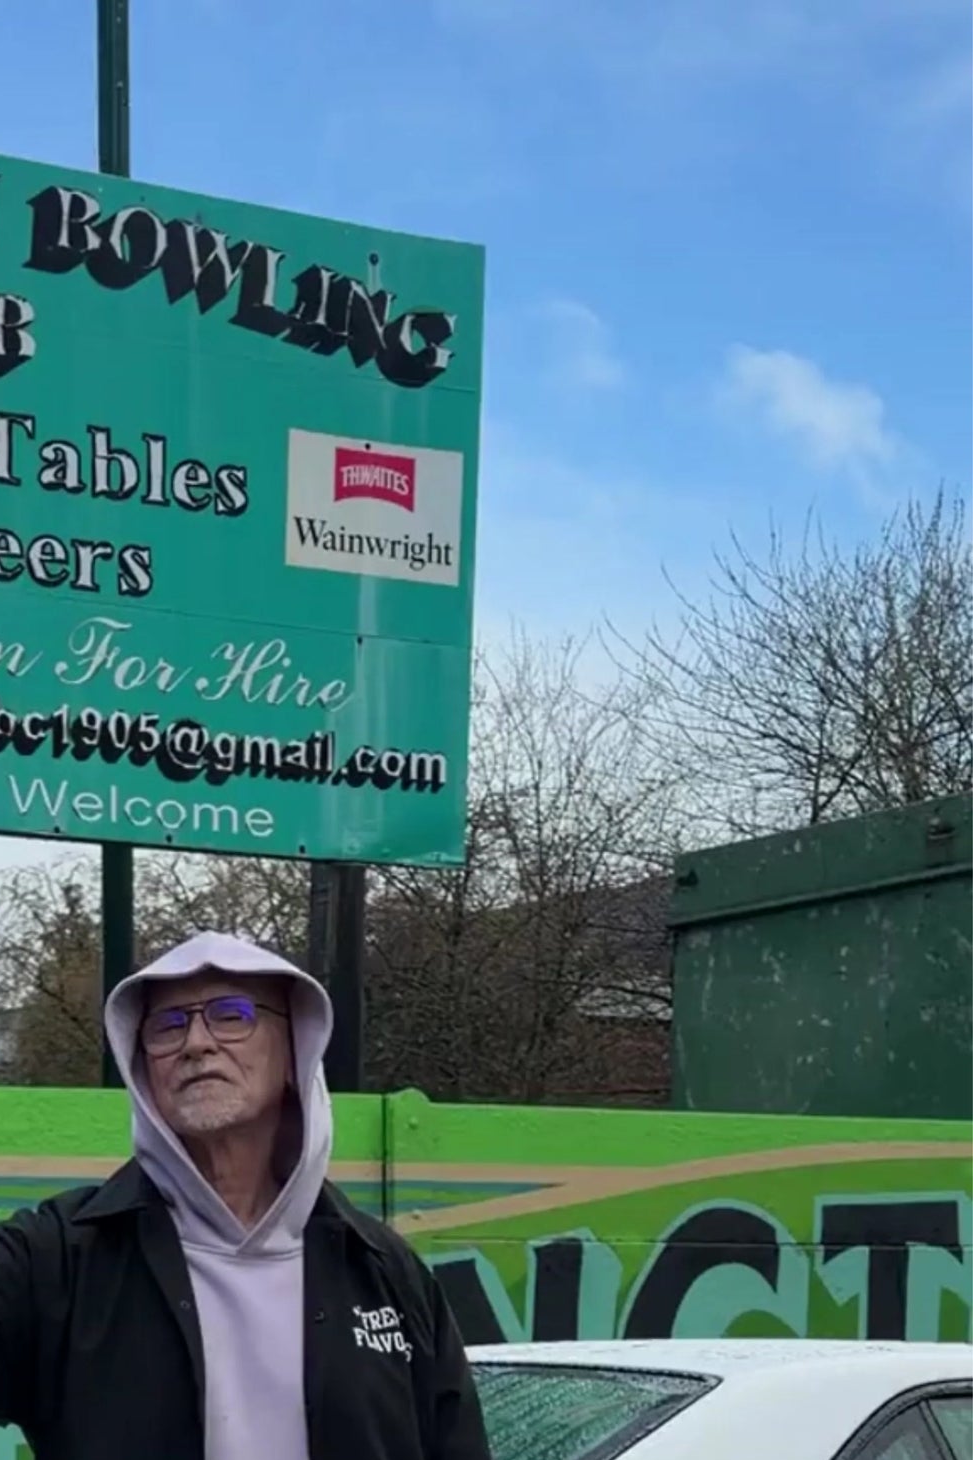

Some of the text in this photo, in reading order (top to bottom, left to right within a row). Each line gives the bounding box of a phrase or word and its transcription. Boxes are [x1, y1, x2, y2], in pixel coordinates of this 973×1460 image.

[22, 186, 458, 388] BOWLING
[340, 464, 409, 495] THWAITES
[294, 516, 453, 571] Wainwright
[54, 615, 194, 695] For
[195, 637, 353, 713] Hire
[8, 774, 275, 837] Welcome
